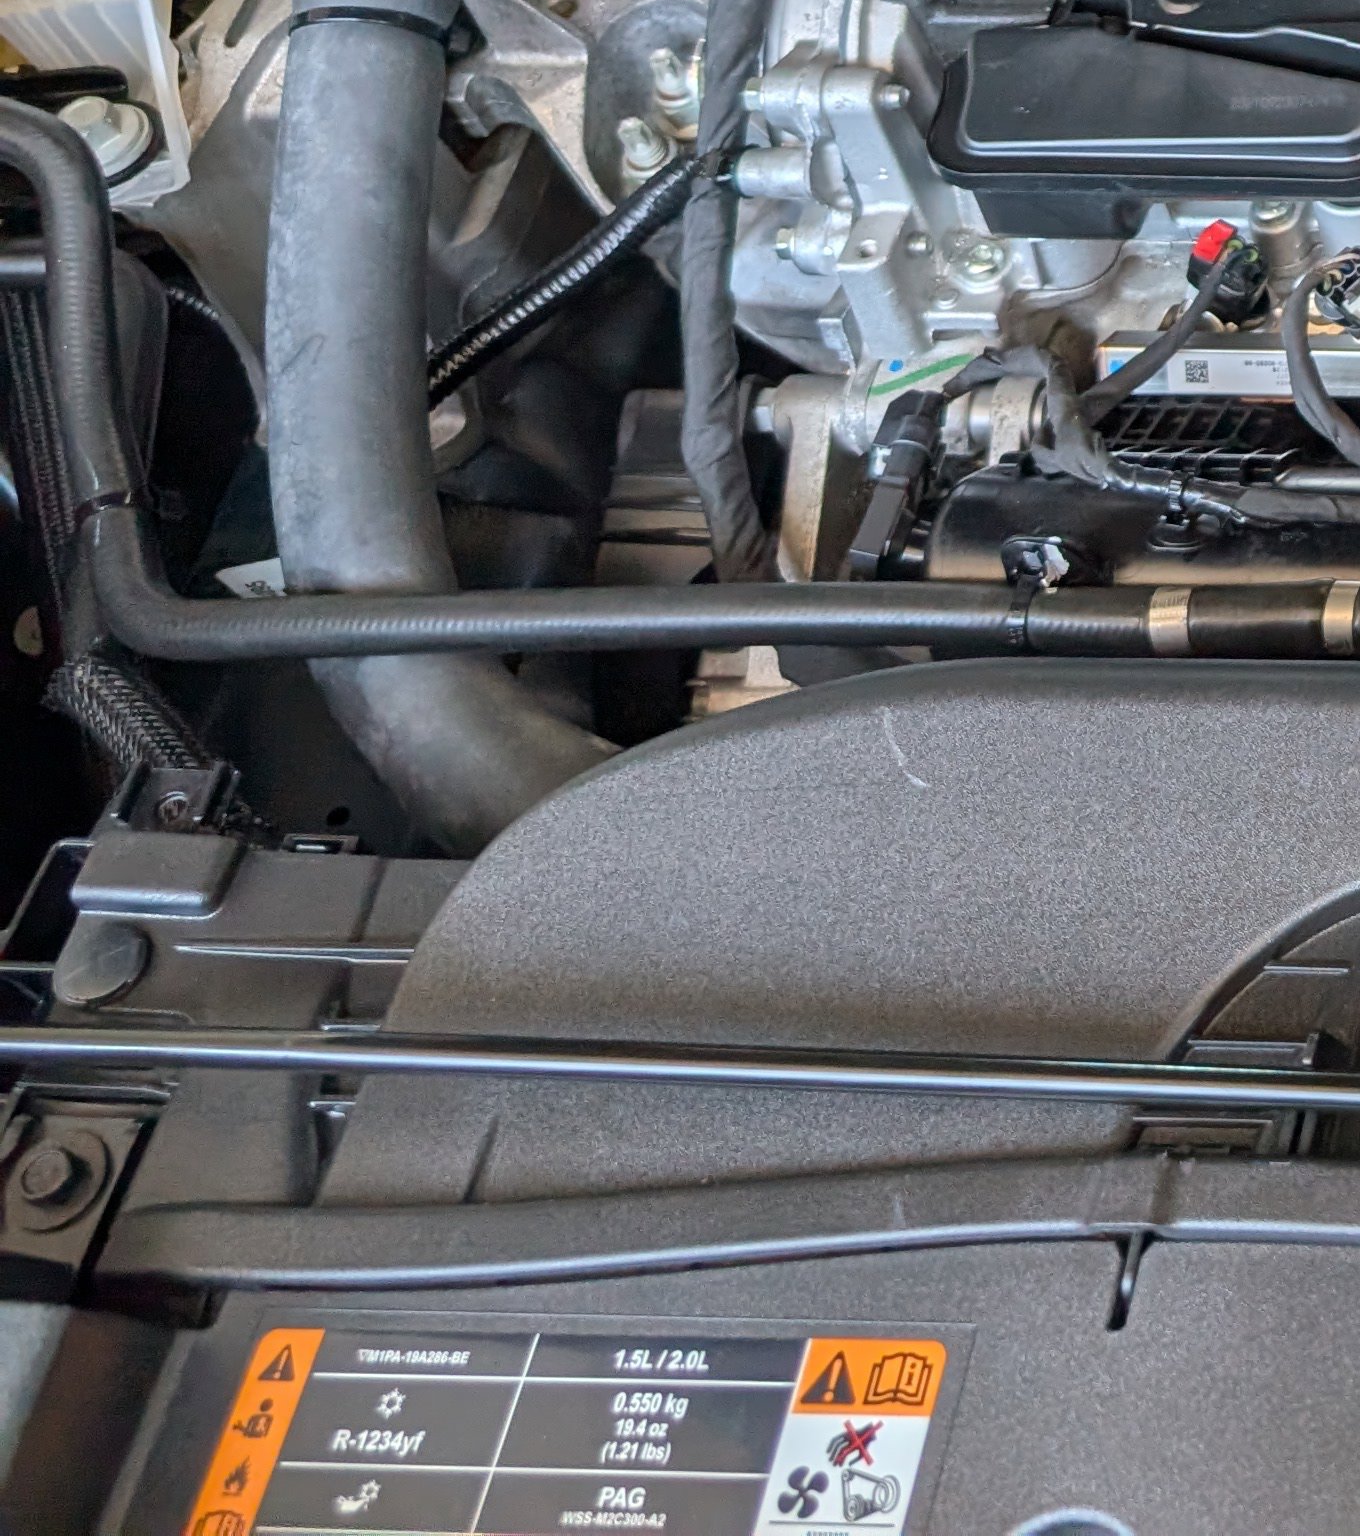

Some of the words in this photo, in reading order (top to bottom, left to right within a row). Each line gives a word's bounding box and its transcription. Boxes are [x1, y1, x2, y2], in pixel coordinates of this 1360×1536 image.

[614, 1349, 653, 1370] 1.5L
[666, 1350, 709, 1371] 2.0L
[612, 1392, 662, 1413] 0.550
[664, 1393, 689, 1419] kg
[615, 1418, 648, 1437] 19.4
[649, 1423, 669, 1437] oz
[332, 1429, 426, 1457] R-1234yf
[600, 1441, 639, 1464] (1.21
[641, 1442, 671, 1464] lbs)
[596, 1486, 647, 1509] PAG
